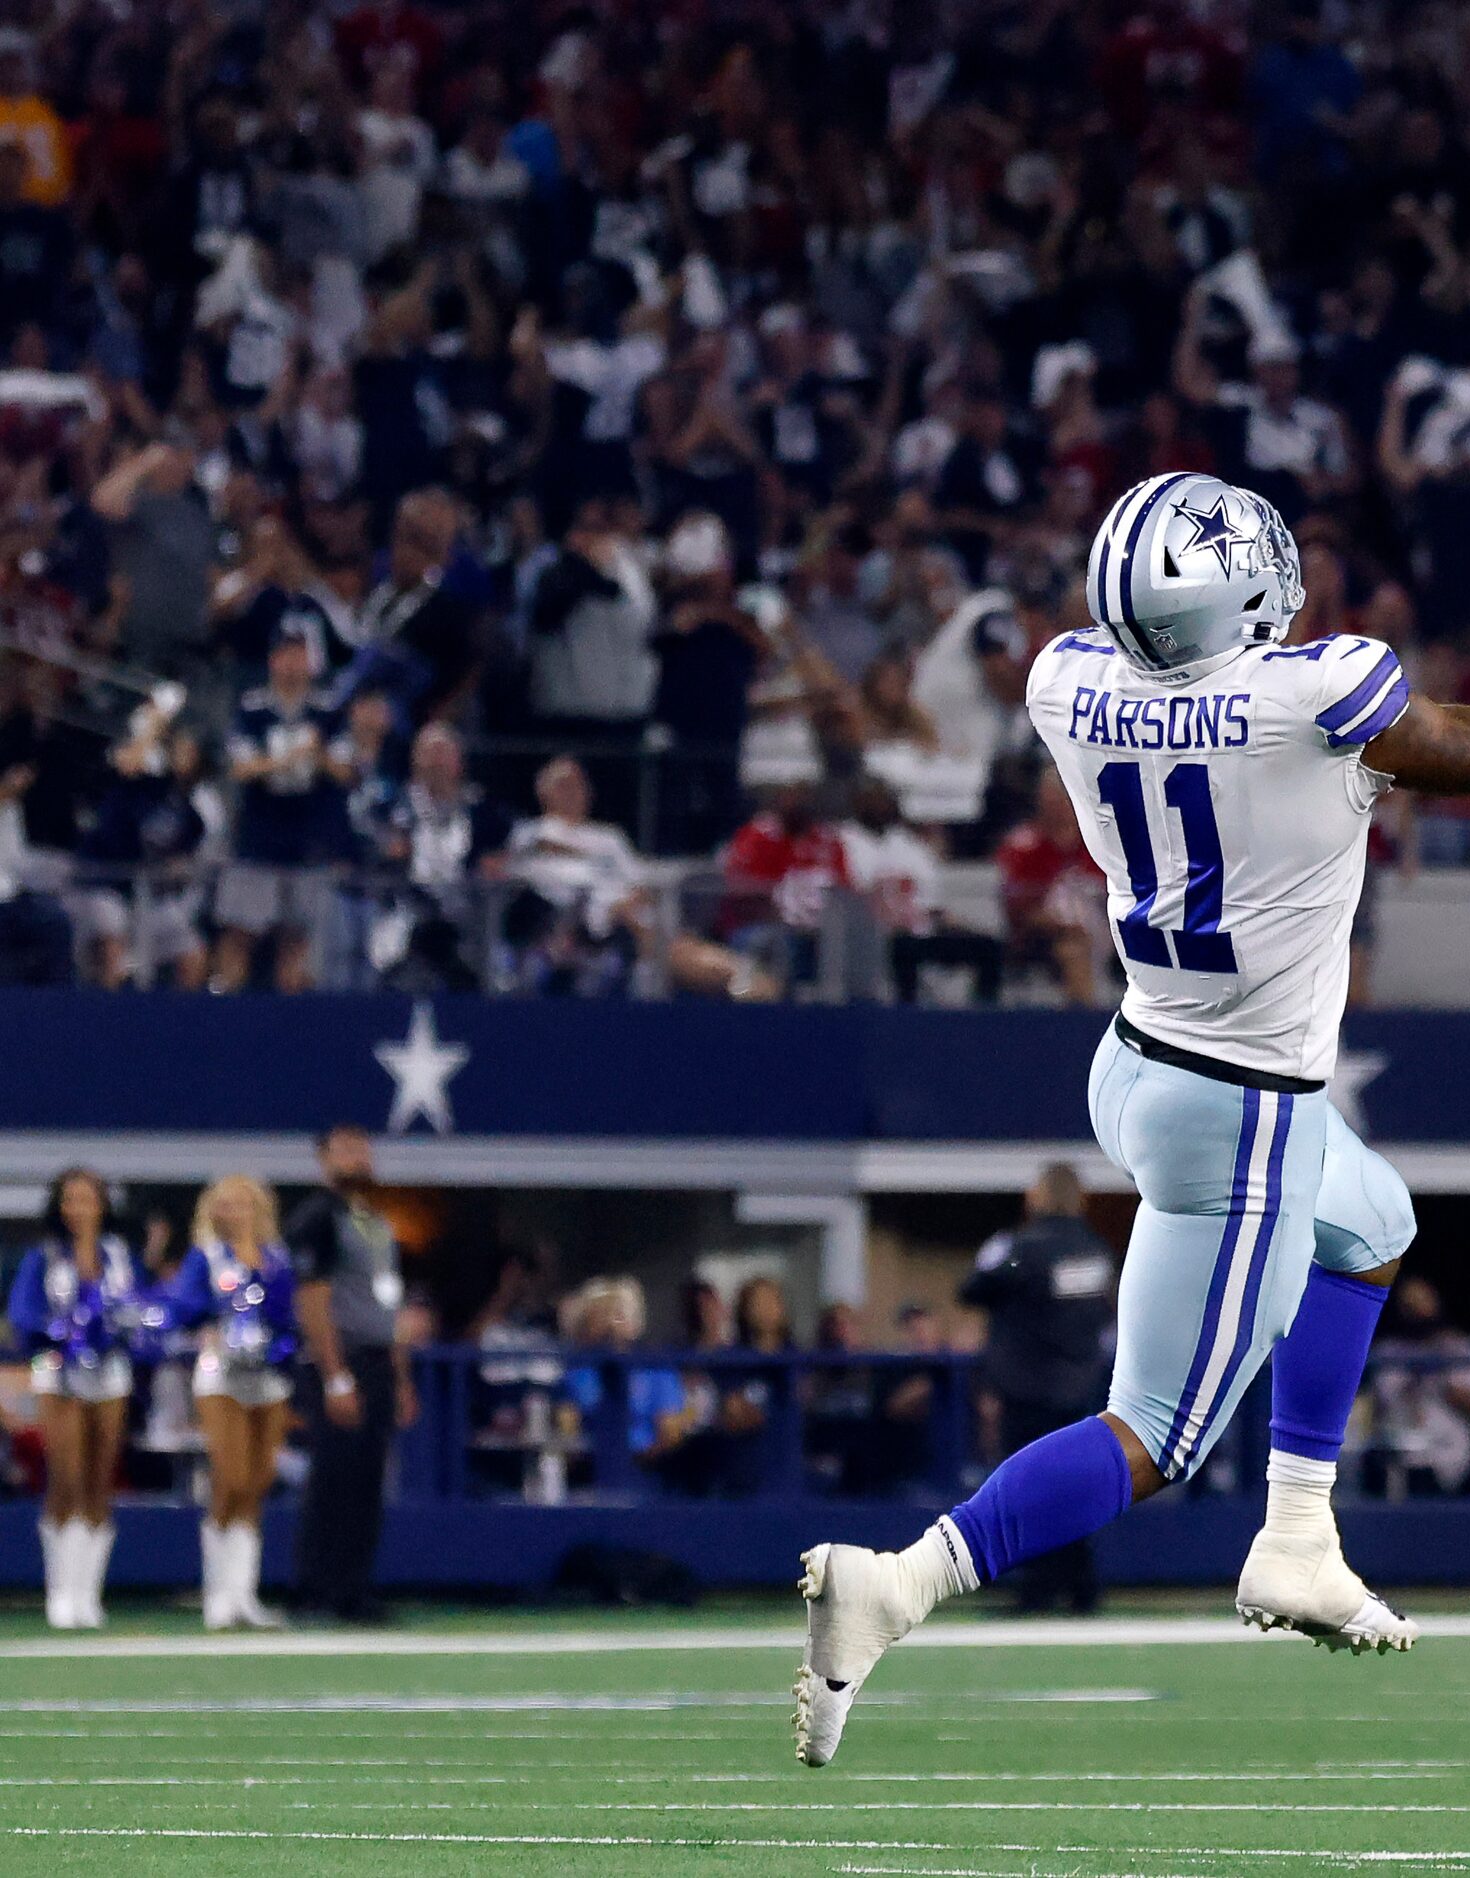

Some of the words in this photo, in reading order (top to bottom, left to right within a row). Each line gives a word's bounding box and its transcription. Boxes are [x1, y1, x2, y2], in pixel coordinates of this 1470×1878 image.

[1069, 687, 1251, 750] PARSONS
[1097, 762, 1239, 974] 11
[937, 1522, 958, 1565] APOR
